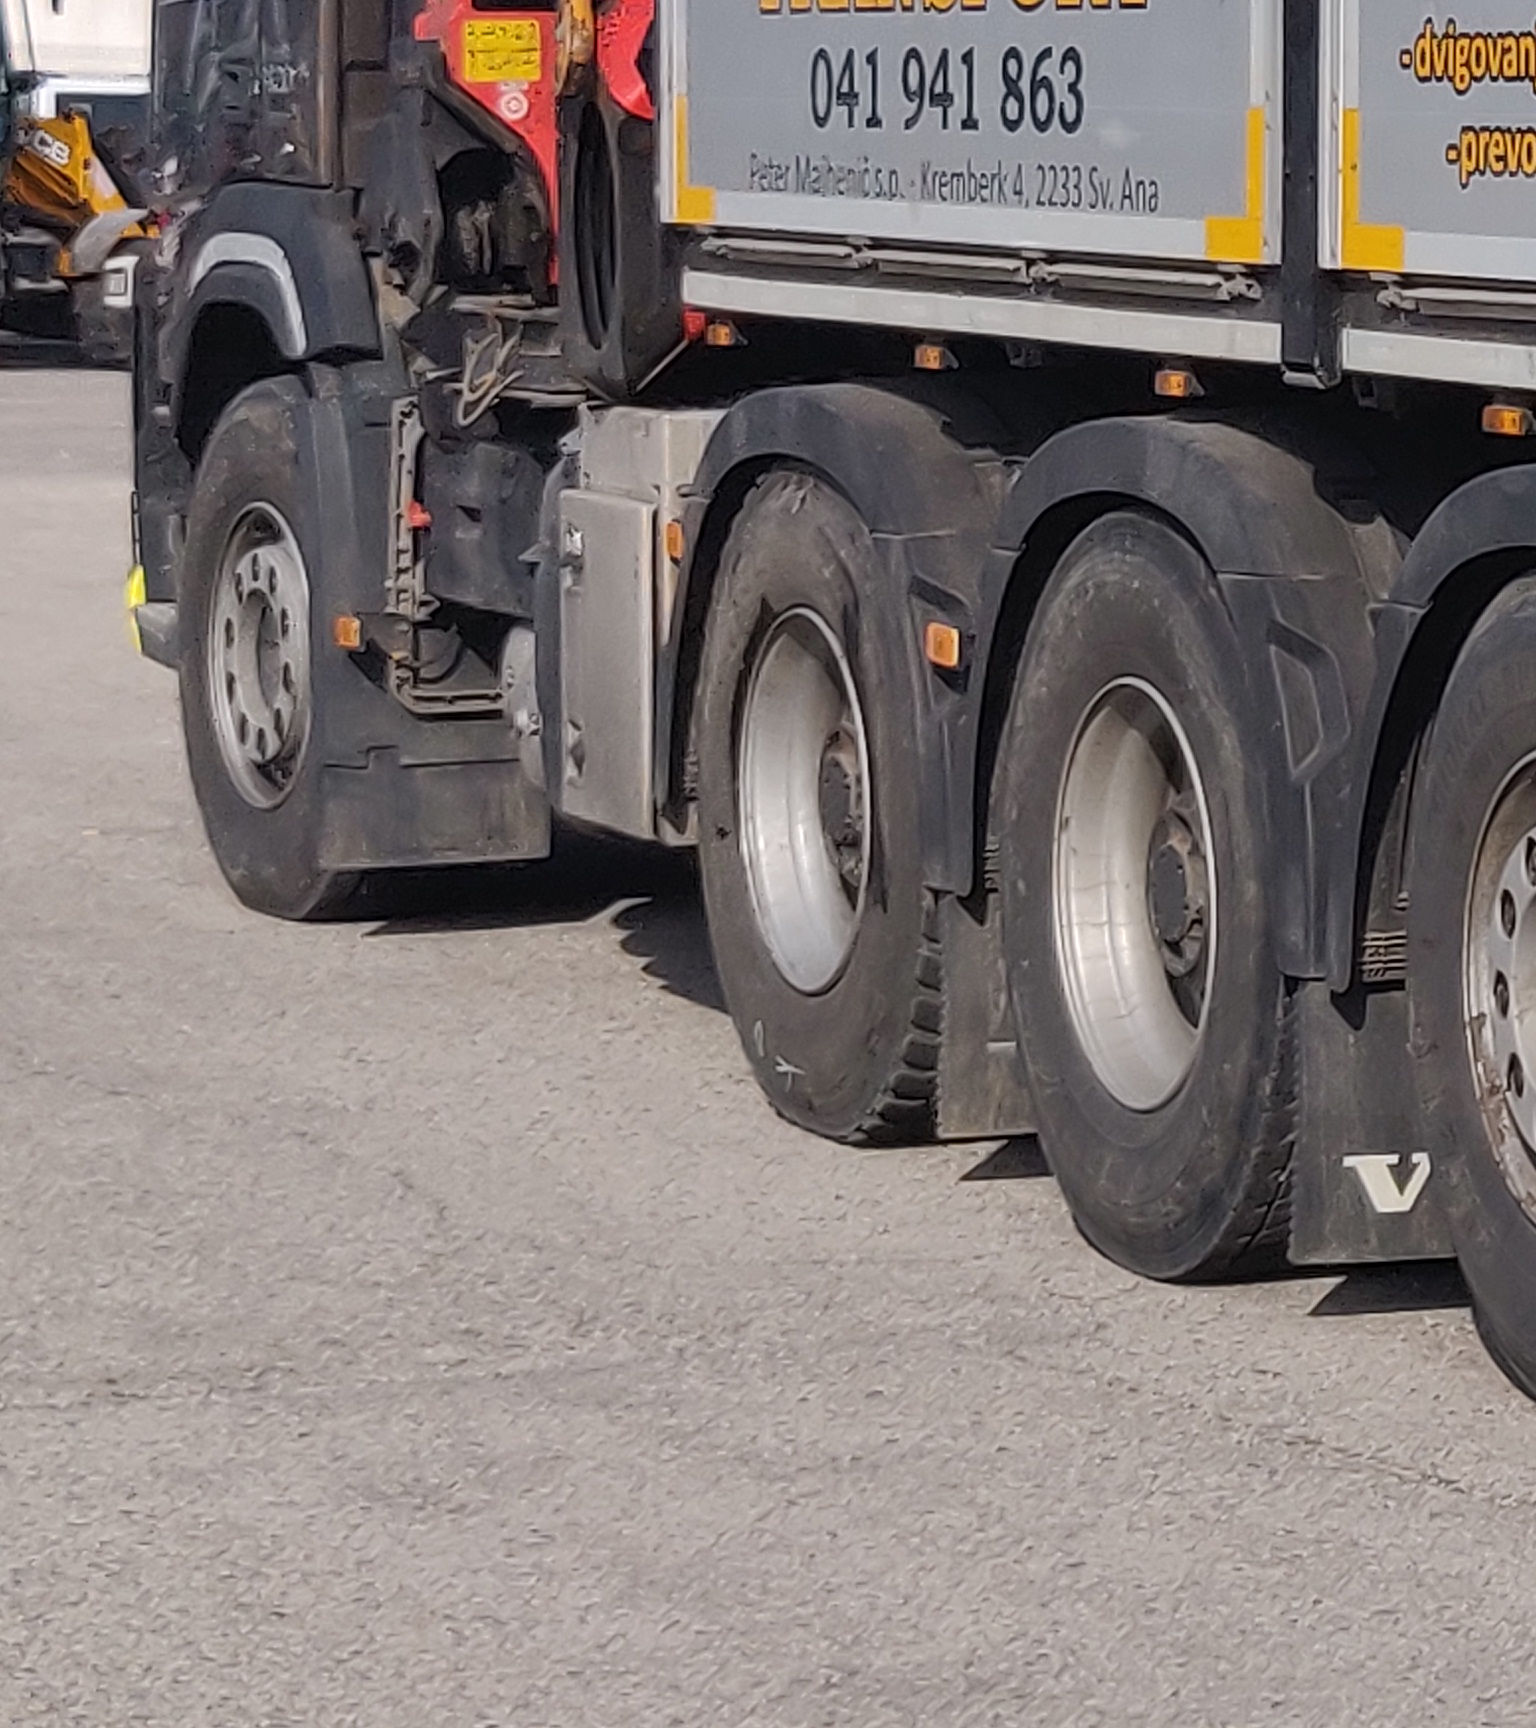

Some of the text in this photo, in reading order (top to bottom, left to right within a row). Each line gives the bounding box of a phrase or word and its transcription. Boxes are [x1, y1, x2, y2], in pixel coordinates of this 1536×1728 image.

[810, 46, 1084, 134] 041 941 863
[919, 157, 1007, 204] Kremberk
[1013, 162, 1029, 208] 4,
[1036, 164, 1082, 209] 2233
[1088, 166, 1114, 210] Sv.
[1120, 167, 1159, 212] Ana
[1343, 1154, 1430, 1214] V
